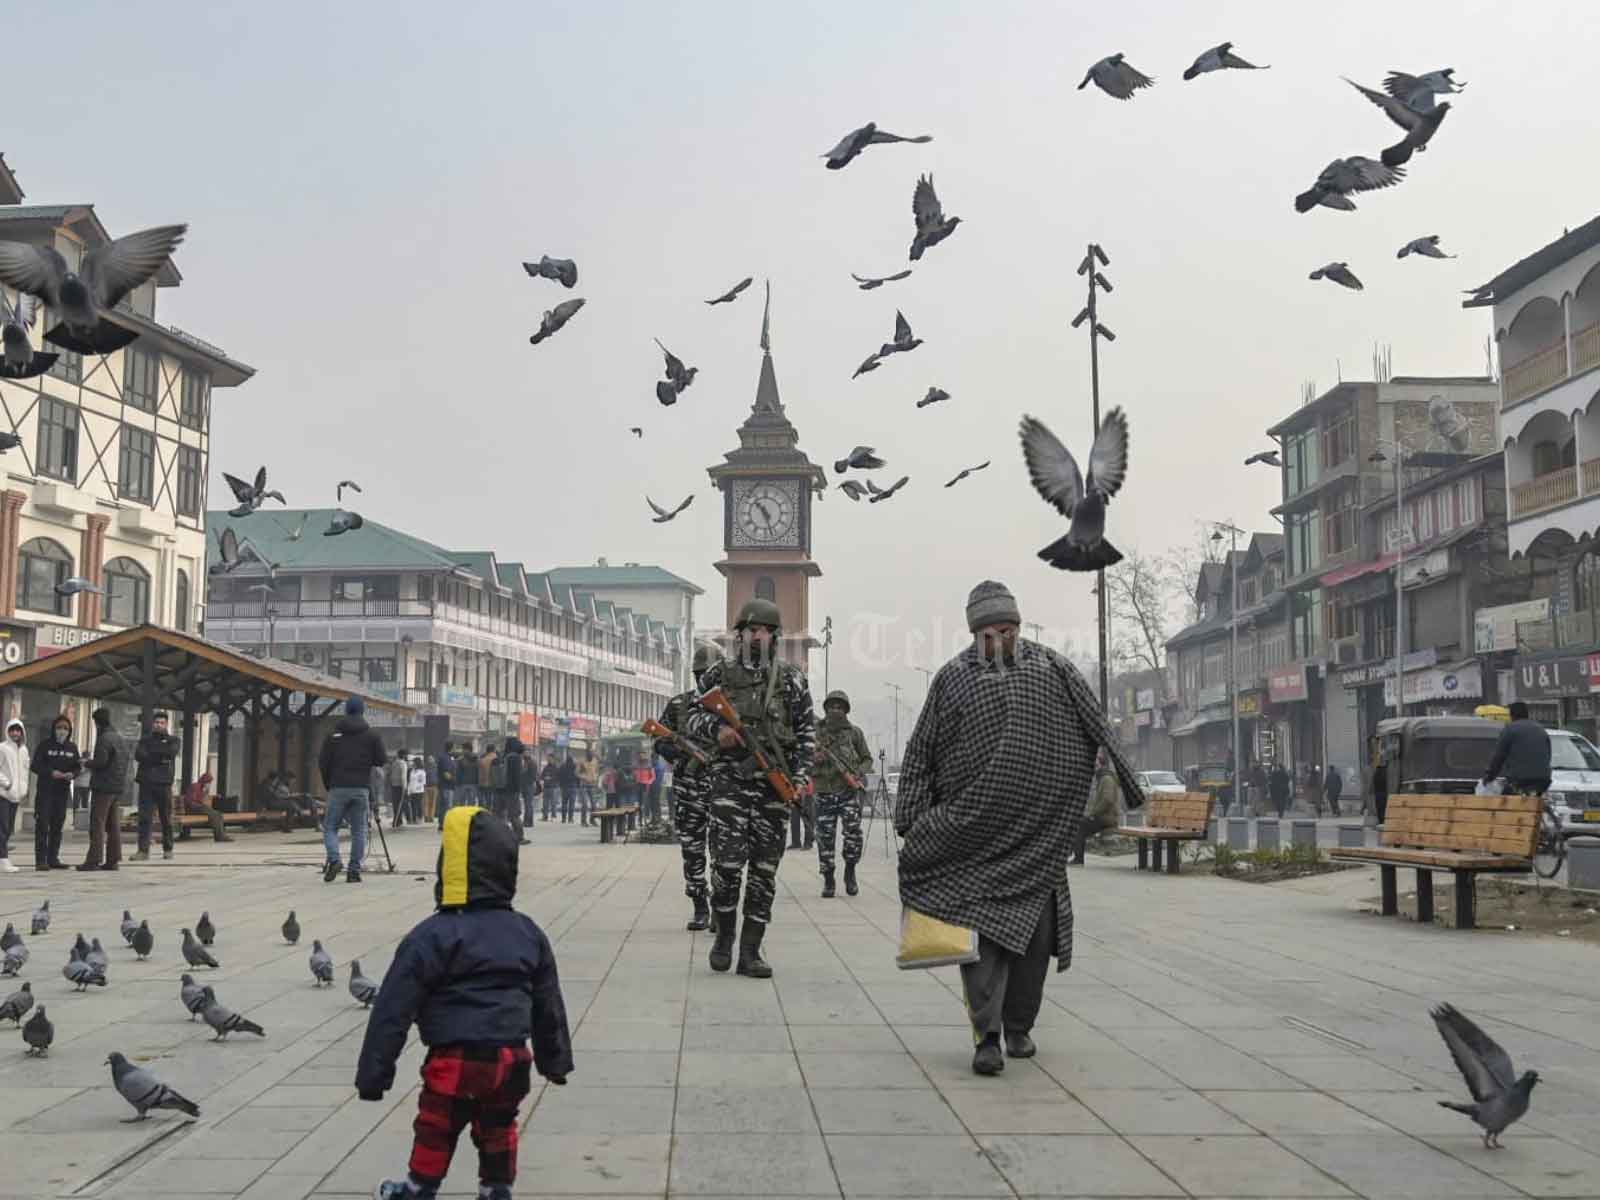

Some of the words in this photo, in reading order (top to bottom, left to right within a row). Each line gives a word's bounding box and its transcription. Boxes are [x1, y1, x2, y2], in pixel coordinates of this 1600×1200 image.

[54, 627, 77, 645] BIG
[1522, 665, 1534, 688] U
[1538, 665, 1550, 688] &
